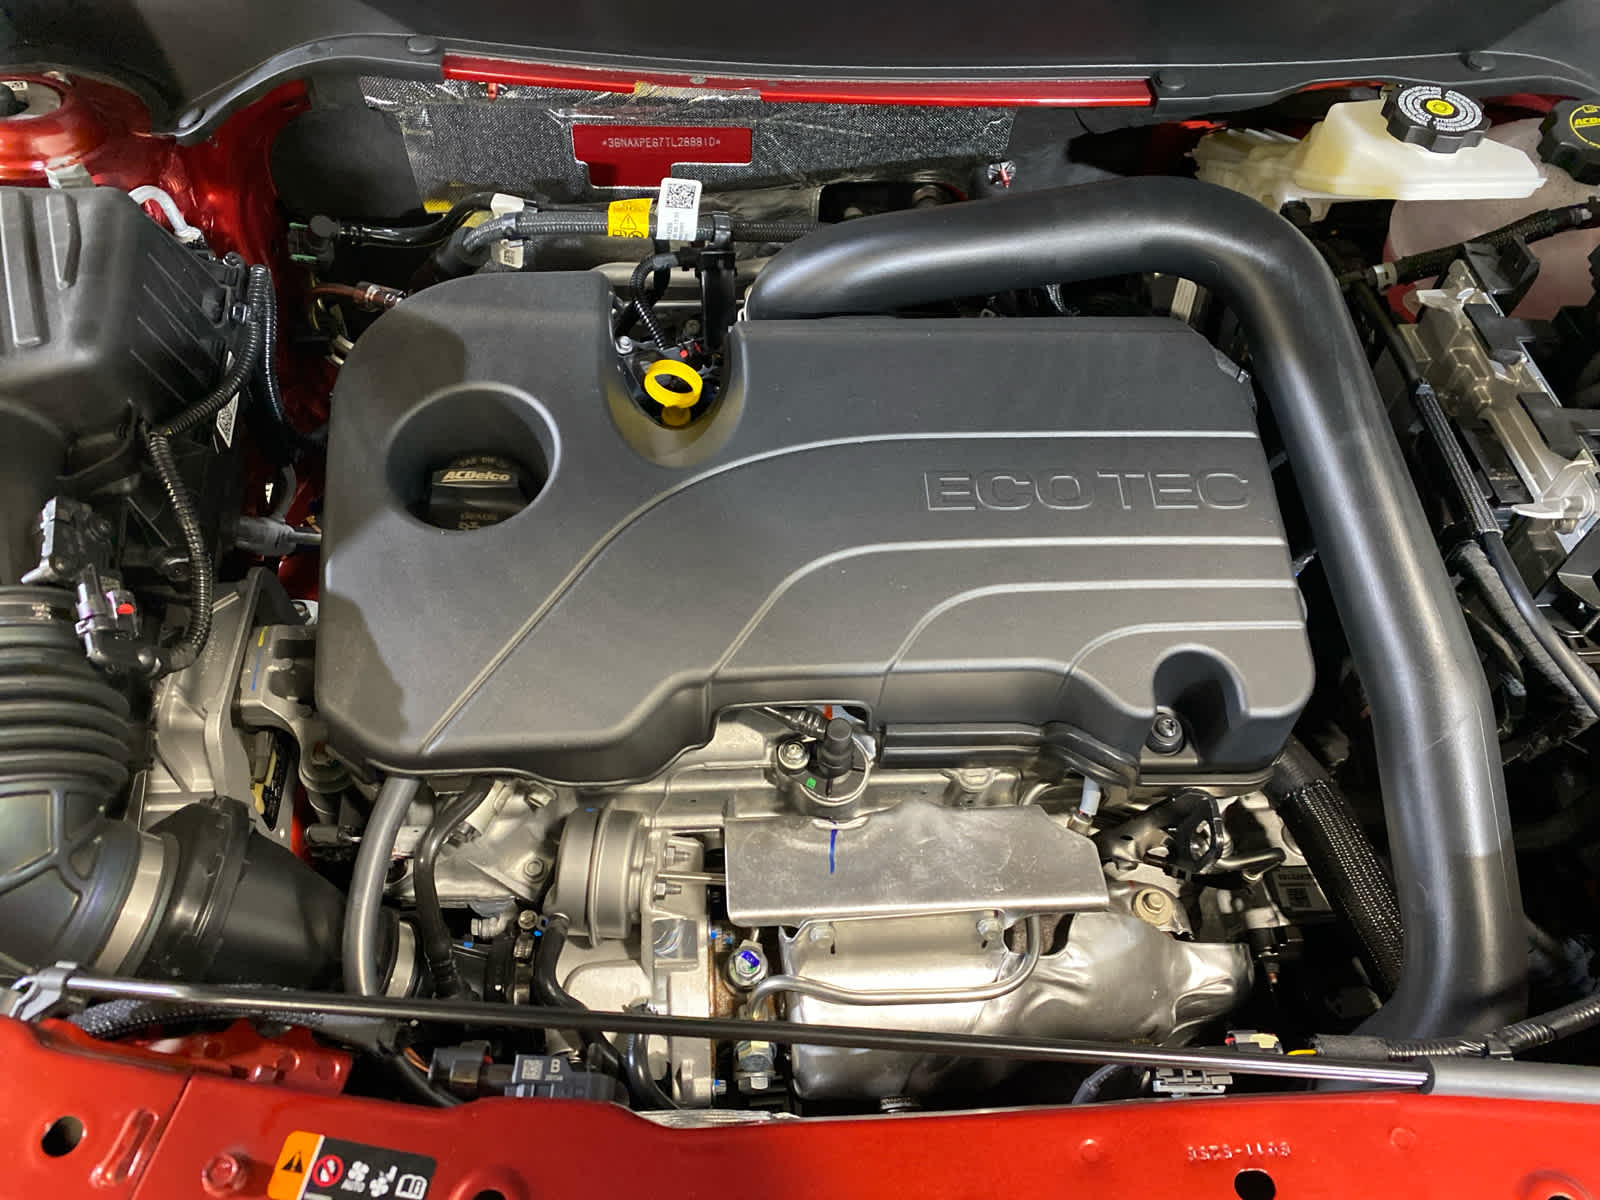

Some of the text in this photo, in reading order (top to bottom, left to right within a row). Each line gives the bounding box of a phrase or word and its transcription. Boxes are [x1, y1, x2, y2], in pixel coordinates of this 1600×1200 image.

[441, 470, 511, 482] ACDelco
[923, 471, 1250, 511] ECOTEC
[550, 1058, 561, 1073] B
[340, 1178, 366, 1193] AUTO
